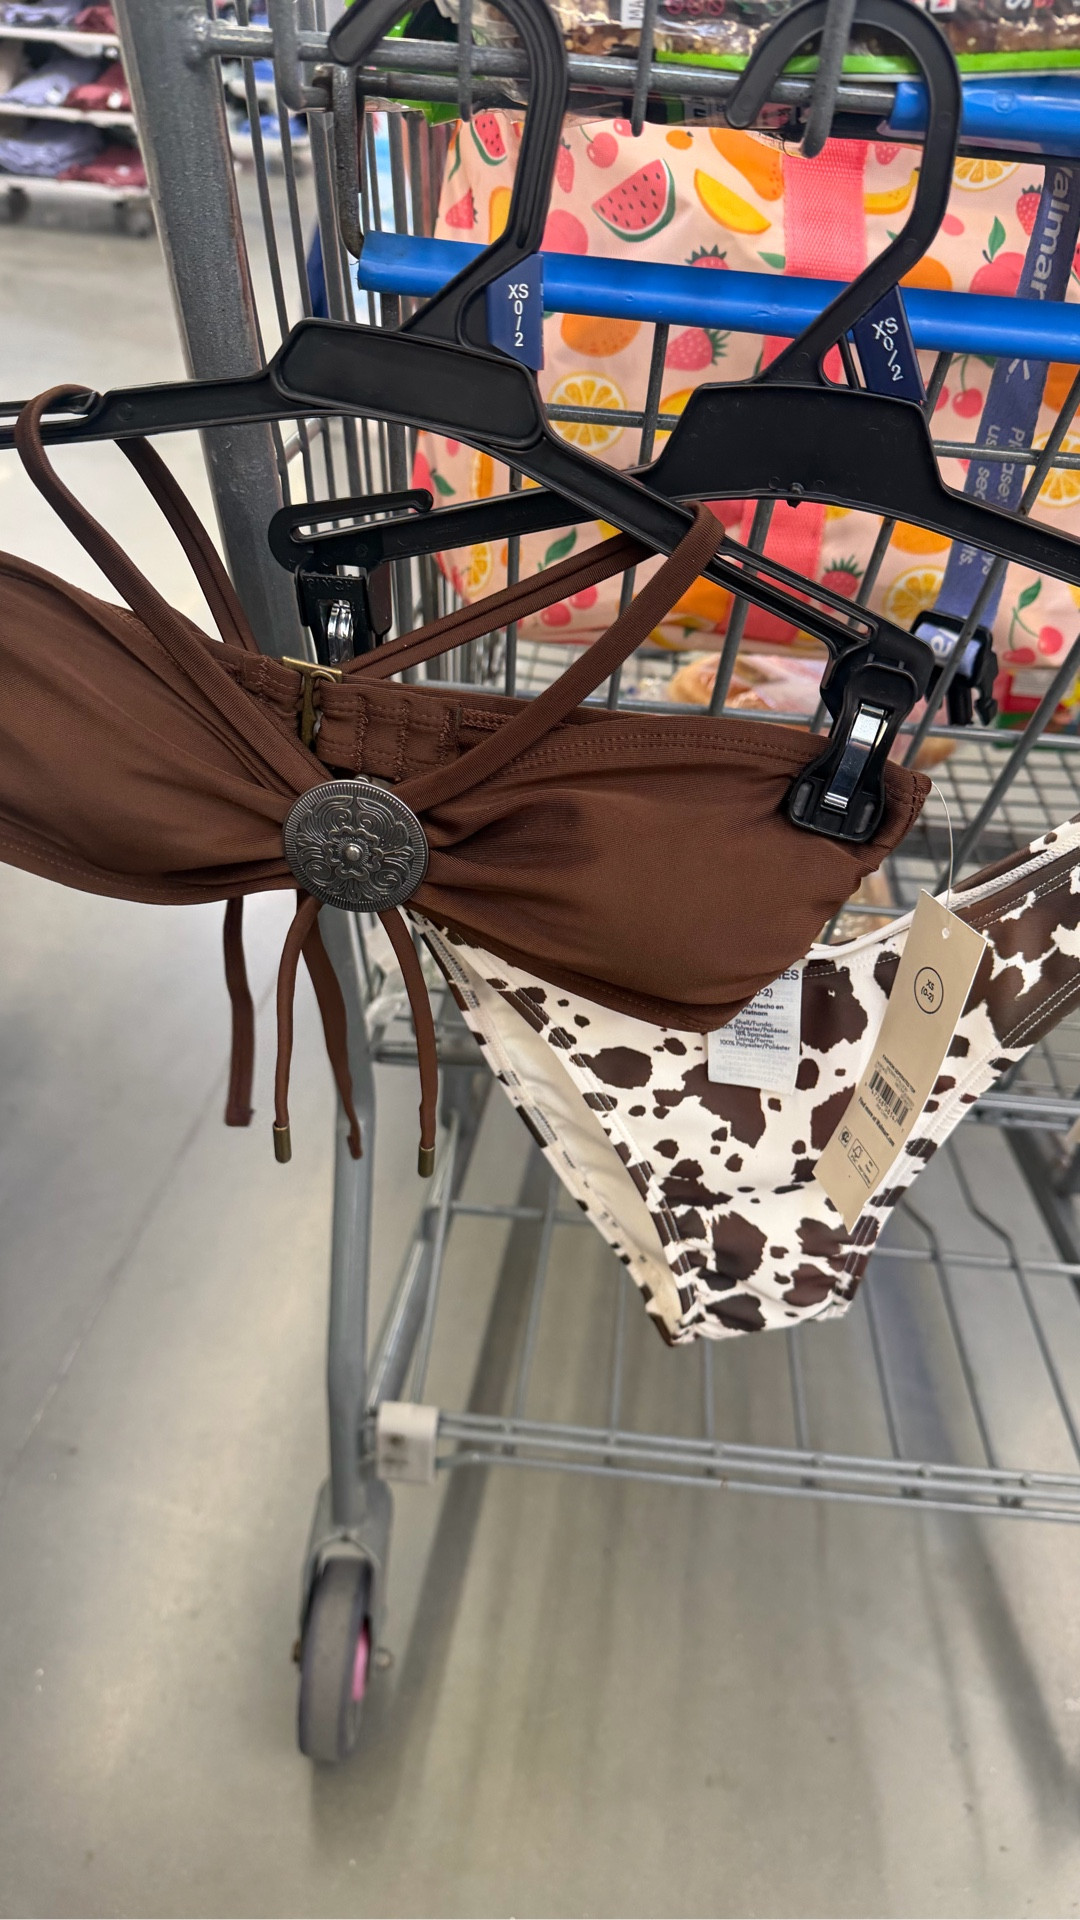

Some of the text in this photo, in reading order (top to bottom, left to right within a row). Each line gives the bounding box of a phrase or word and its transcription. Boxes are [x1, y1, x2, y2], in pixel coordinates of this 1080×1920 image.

[1031, 167, 1074, 299] almar
[508, 284, 529, 299] XS
[872, 317, 899, 339] XS
[985, 424, 1001, 448] us
[997, 427, 1026, 502] Plase:
[921, 986, 935, 1003] (0-2)
[926, 979, 935, 991] XS
[746, 1003, 775, 1011] n/Hecho
